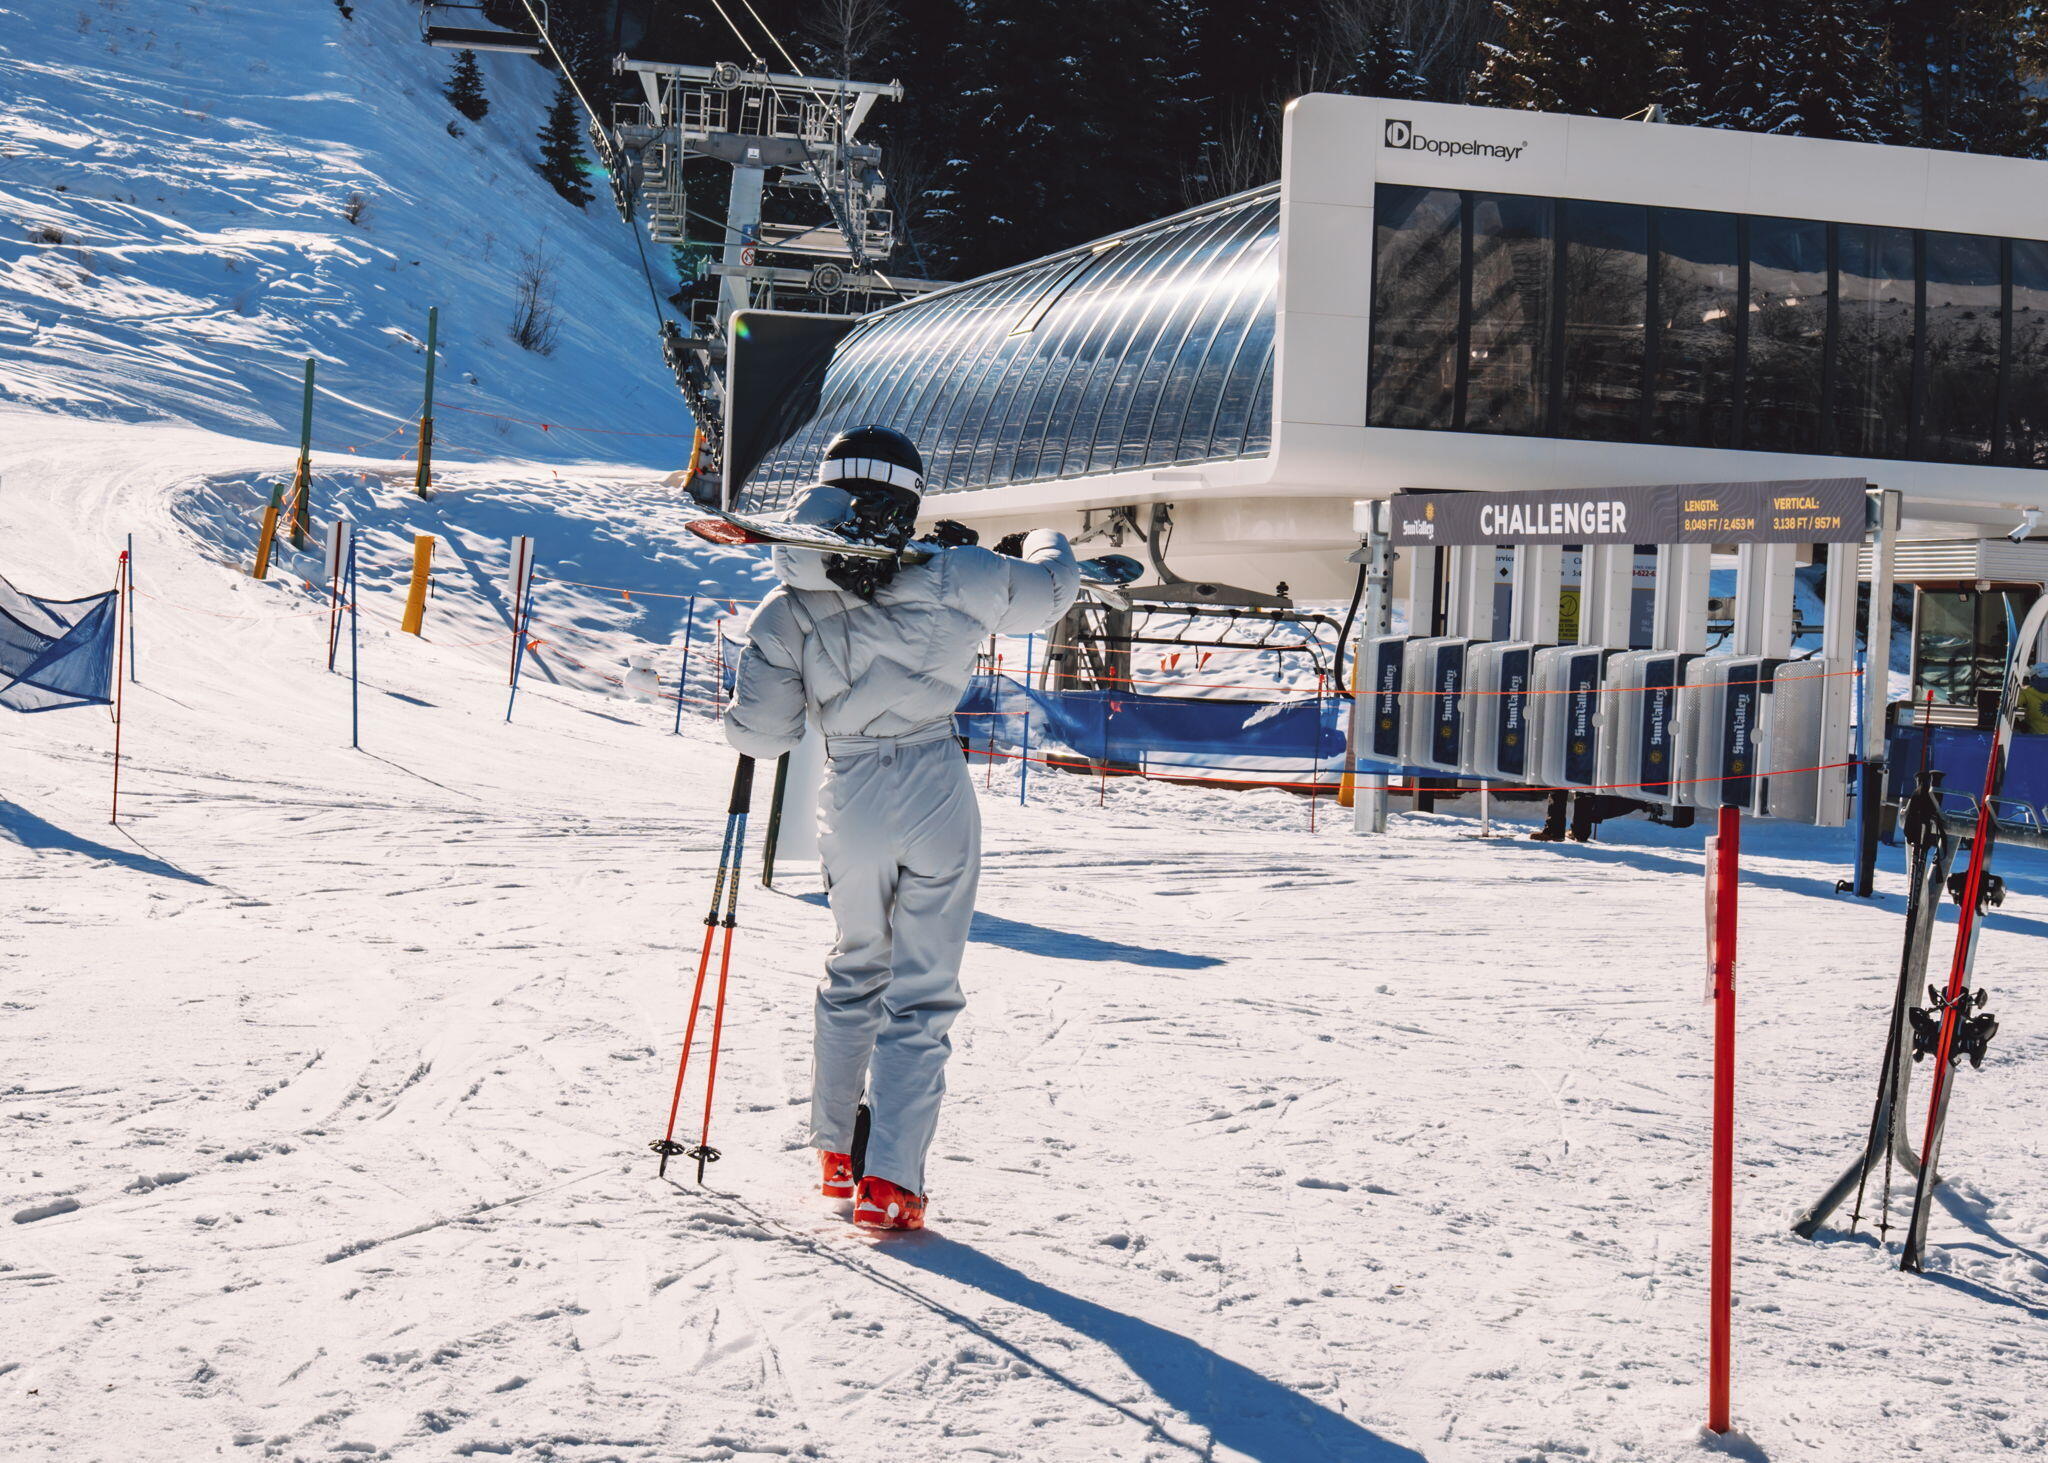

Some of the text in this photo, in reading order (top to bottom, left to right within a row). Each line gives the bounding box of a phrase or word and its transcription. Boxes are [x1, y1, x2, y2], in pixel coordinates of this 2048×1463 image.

[1684, 499, 1719, 512] LENGTH:
[1774, 497, 1820, 510] VERTICAL:
[1480, 501, 1627, 535] CHALLENGER
[1684, 517, 1755, 532] 8,049 FT / 2,453 M
[1773, 516, 1841, 531] 3,138 FT / 957 M
